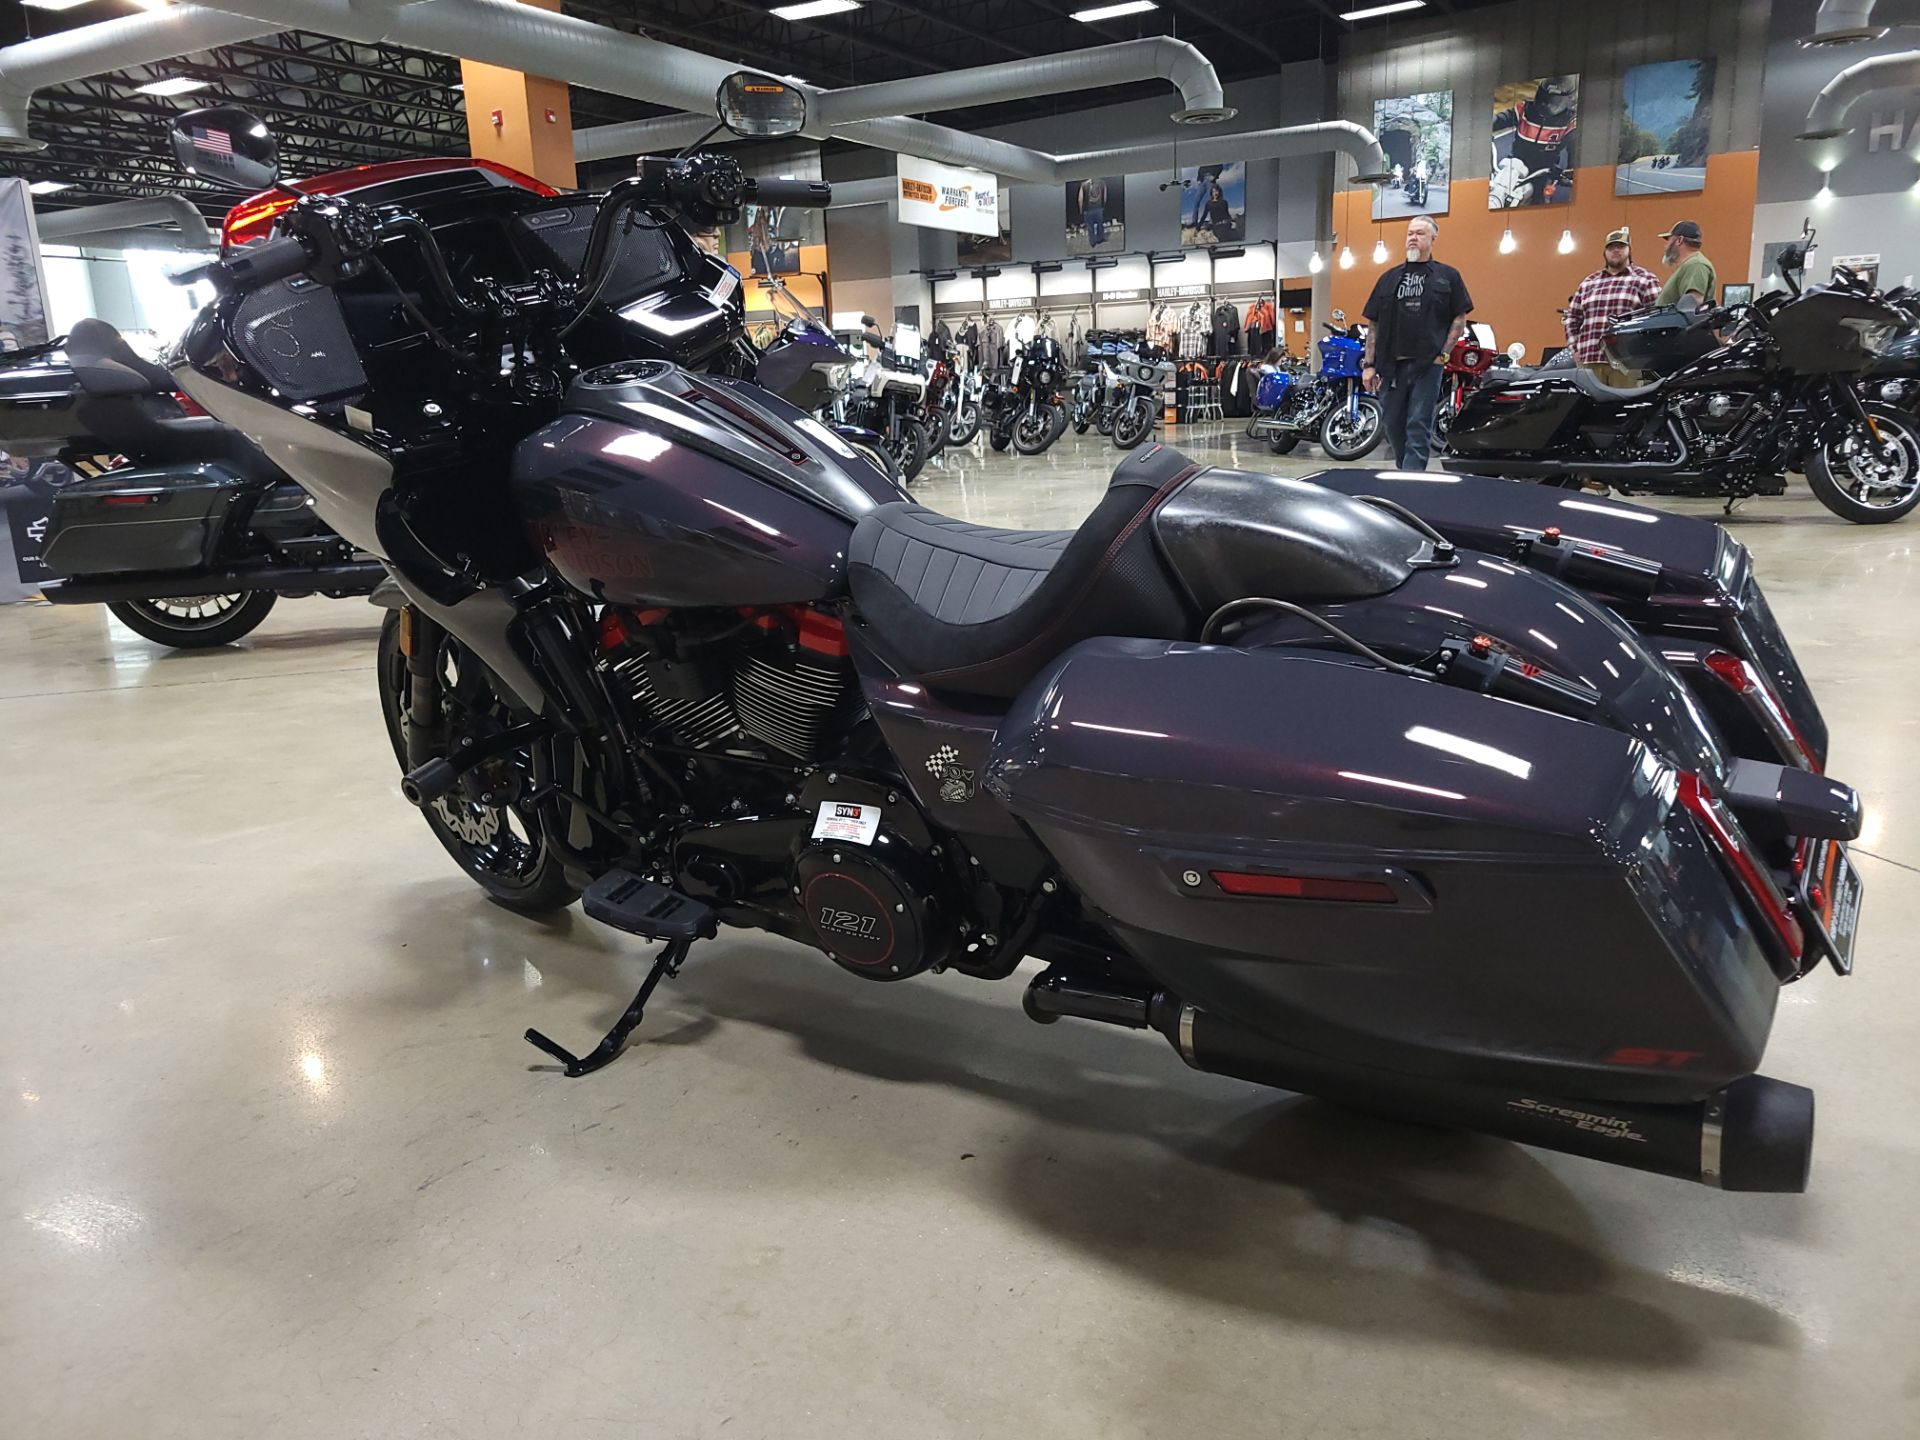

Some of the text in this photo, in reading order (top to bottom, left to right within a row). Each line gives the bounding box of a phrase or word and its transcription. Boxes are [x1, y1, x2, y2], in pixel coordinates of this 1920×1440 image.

[941, 186, 968, 199] WARRANTY
[1156, 284, 1206, 298] HARLEY-DAVIDSON
[820, 906, 877, 934] 121
[821, 924, 842, 933] HIGH
[1575, 1119, 1648, 1143] Eagle
